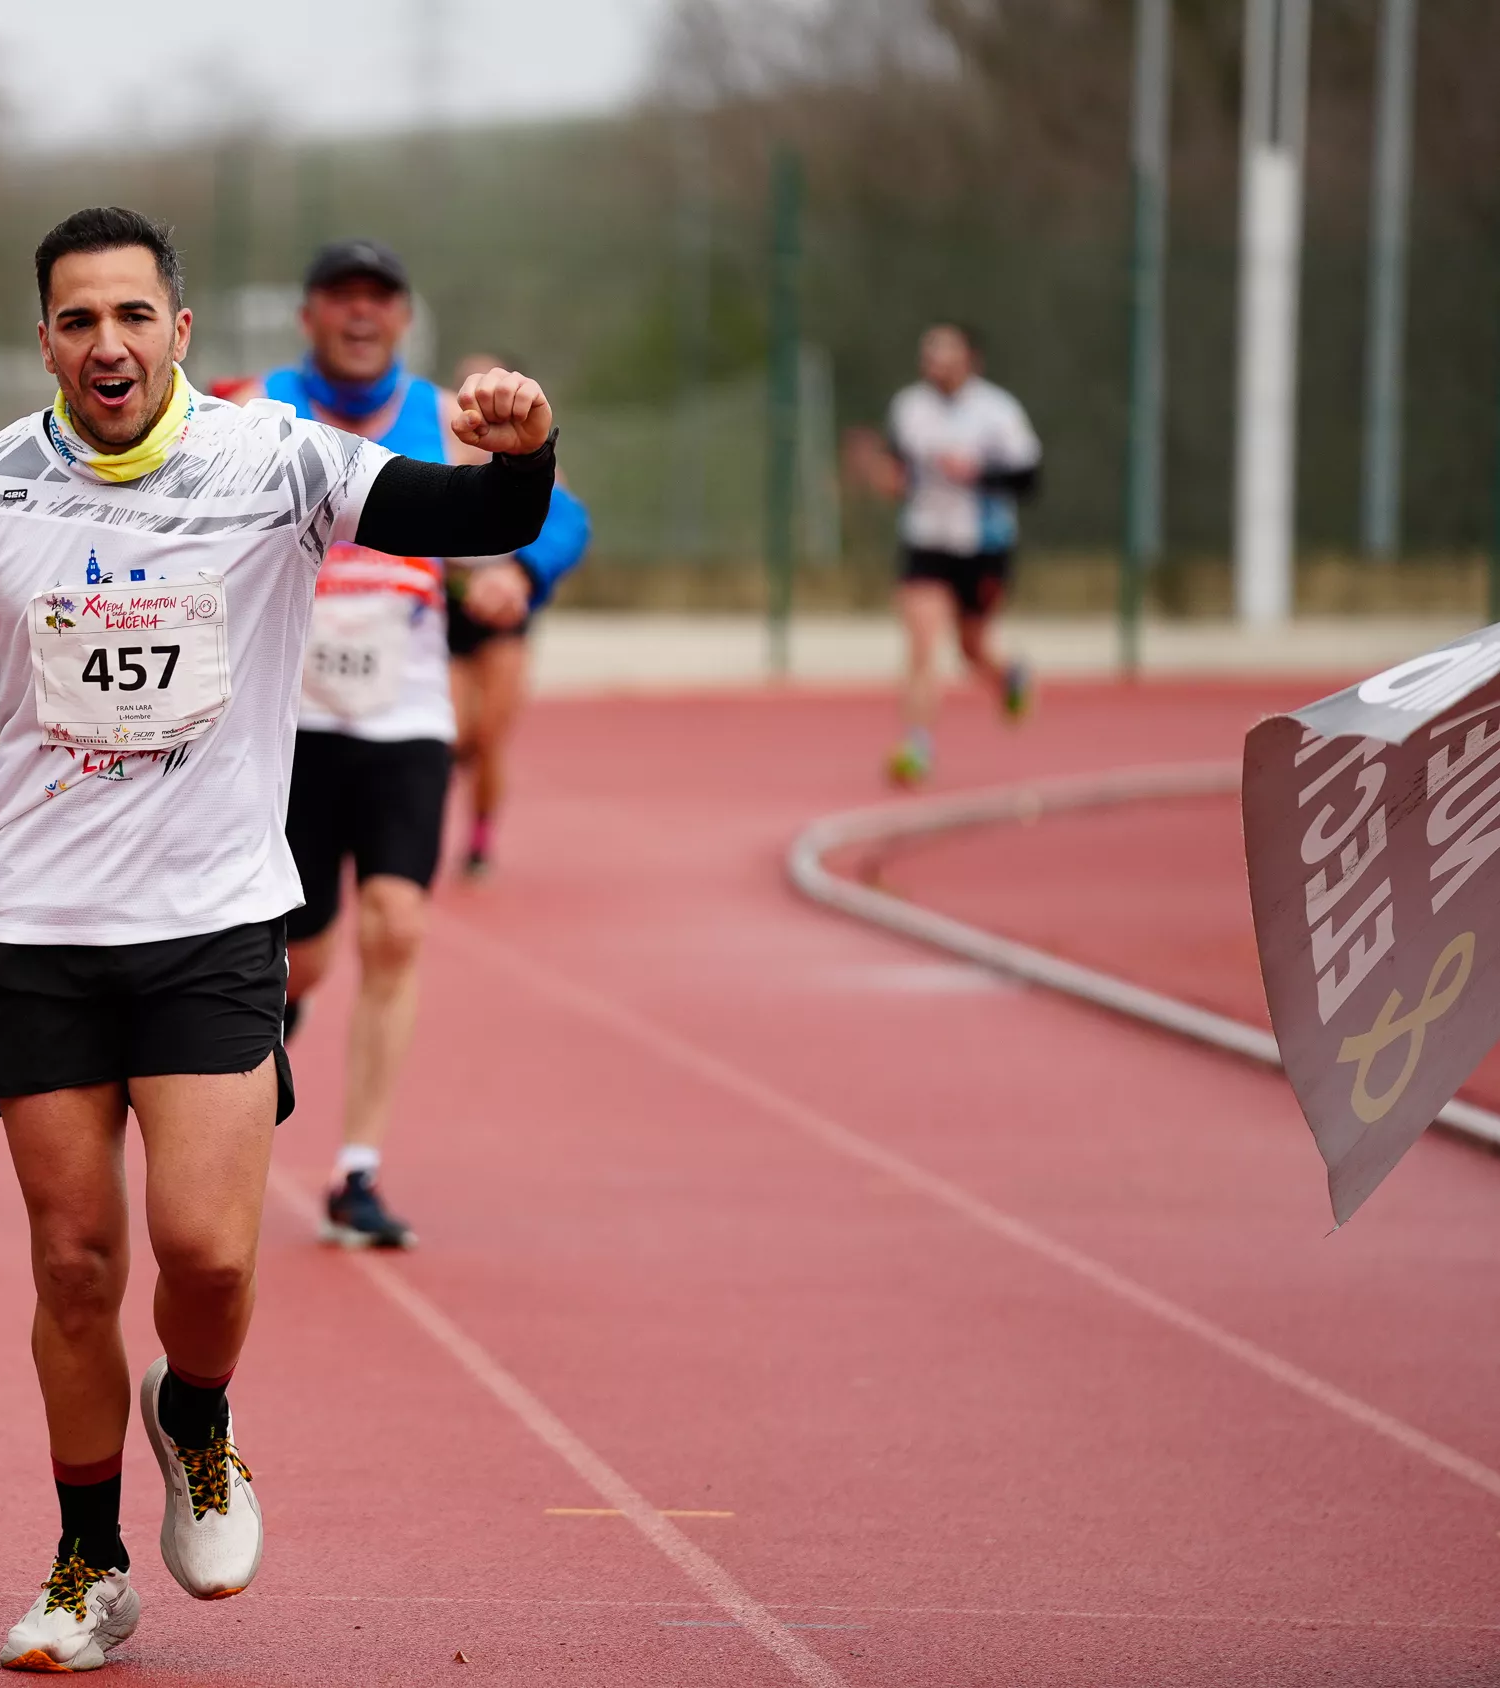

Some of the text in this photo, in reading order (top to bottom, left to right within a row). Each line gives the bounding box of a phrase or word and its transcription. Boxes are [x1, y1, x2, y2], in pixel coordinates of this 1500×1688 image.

[4, 490, 26, 499] 42K
[82, 593, 101, 618] X
[105, 613, 167, 630] LUCENA
[82, 645, 181, 692] 457
[119, 713, 151, 721] L-Hombre
